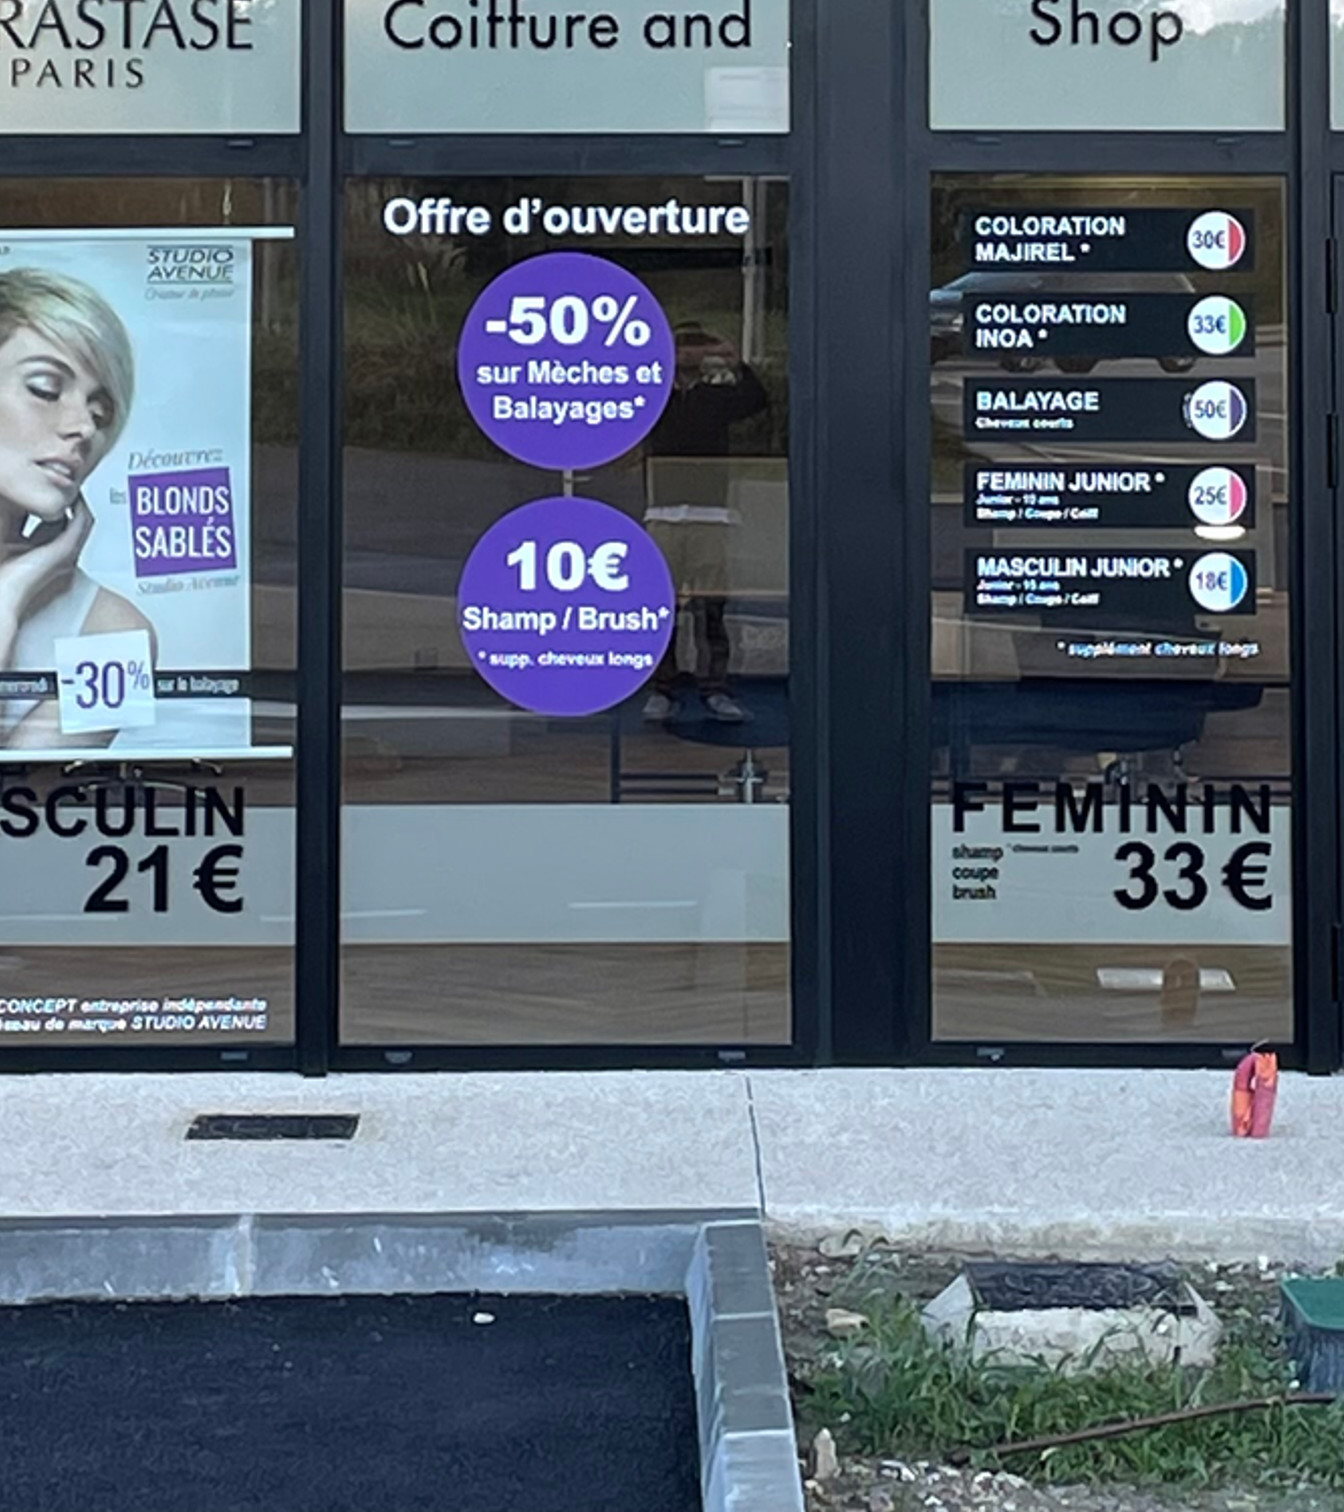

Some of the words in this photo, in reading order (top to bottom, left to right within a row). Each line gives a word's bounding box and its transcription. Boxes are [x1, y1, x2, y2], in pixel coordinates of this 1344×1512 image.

[11, 58, 144, 87] PARIS
[383, 198, 491, 235] Offre
[503, 198, 750, 235] d'ouverture
[974, 216, 1126, 236] COLORATION
[1191, 230, 1226, 250] 30€
[147, 248, 234, 264] STUDIO
[974, 242, 1076, 262] MAJIREL
[148, 265, 233, 280] AVENUE
[485, 295, 651, 347] -50%
[975, 304, 1127, 324] COLORATION
[1193, 315, 1227, 335] 33€
[976, 328, 1034, 348] INOA
[476, 365, 521, 385] sur
[527, 359, 629, 385] Mèches
[635, 361, 663, 385] et
[976, 391, 1100, 410] BALAYAGE
[1194, 399, 1227, 419] 50€
[128, 449, 223, 470] Découvrez
[976, 471, 1065, 492] FEMININ
[1068, 471, 1152, 492] JUNIOR
[136, 485, 230, 515] BLONDS
[1194, 486, 1227, 506] 25€
[135, 516, 232, 559] SABLÉS
[507, 541, 630, 592] 10€
[977, 557, 1088, 577] MASCULIN
[1090, 557, 1171, 577] JUNIOR
[1196, 570, 1227, 590] 18€
[462, 606, 556, 636] Shamp
[1067, 640, 1152, 657] supplément
[1154, 640, 1216, 656] cheveux
[1218, 641, 1259, 658] longs
[489, 653, 534, 669] supp.
[537, 651, 604, 665] cheveux
[608, 651, 653, 669] longs
[61, 660, 150, 709] -30%
[953, 783, 1270, 833] FEMININ
[953, 844, 1003, 861] shamp
[953, 866, 999, 882] coupe
[953, 885, 997, 900] brush
[80, 999, 159, 1014] entreprise
[44, 1017, 66, 1032] de
[68, 1018, 128, 1034] marque
[130, 1014, 196, 1031] STUDIO
[198, 1014, 268, 1031] AVENUE
